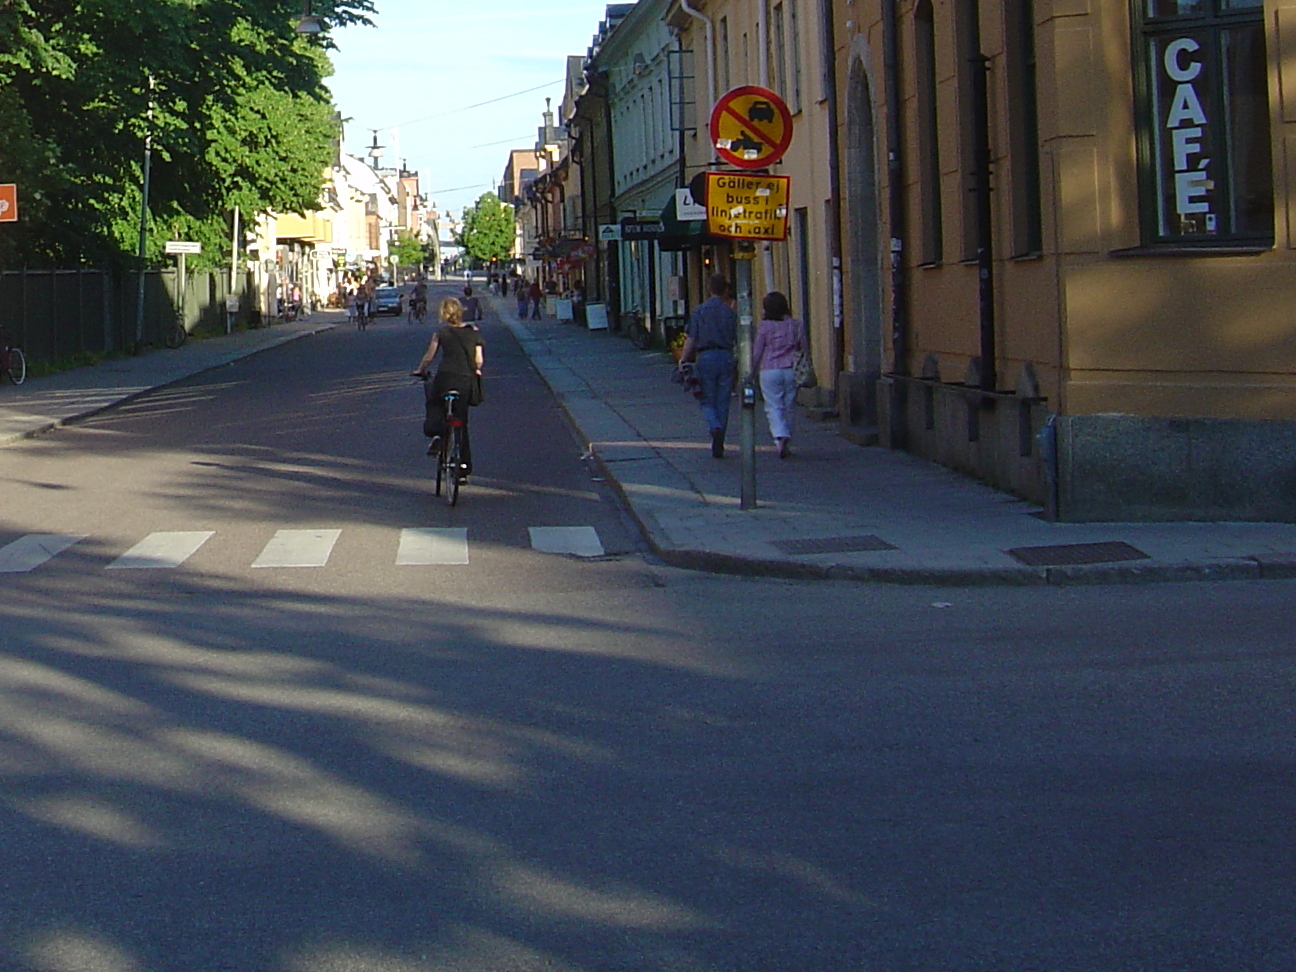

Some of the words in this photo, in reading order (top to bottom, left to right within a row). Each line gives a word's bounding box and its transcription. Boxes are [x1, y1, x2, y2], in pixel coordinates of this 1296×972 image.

[716, 176, 762, 190] Gäller
[766, 179, 781, 194] ej
[725, 192, 760, 205] buss
[718, 222, 743, 234] och
